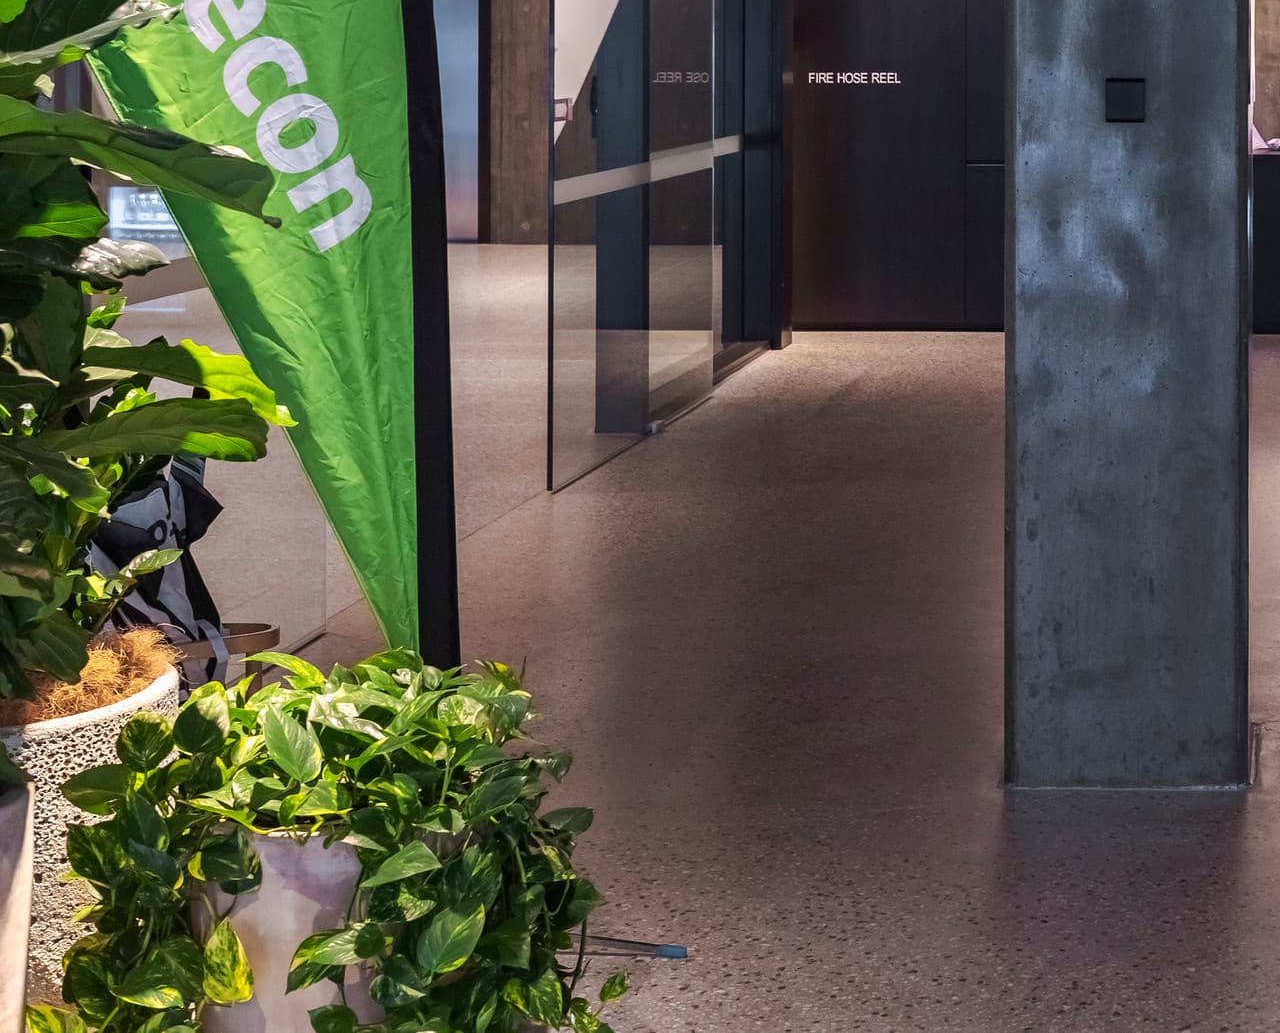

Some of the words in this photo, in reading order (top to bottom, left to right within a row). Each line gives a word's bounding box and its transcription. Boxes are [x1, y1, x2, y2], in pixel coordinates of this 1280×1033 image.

[808, 72, 834, 84] FIRE
[837, 72, 868, 84] HOSE
[871, 72, 901, 84] REEL
